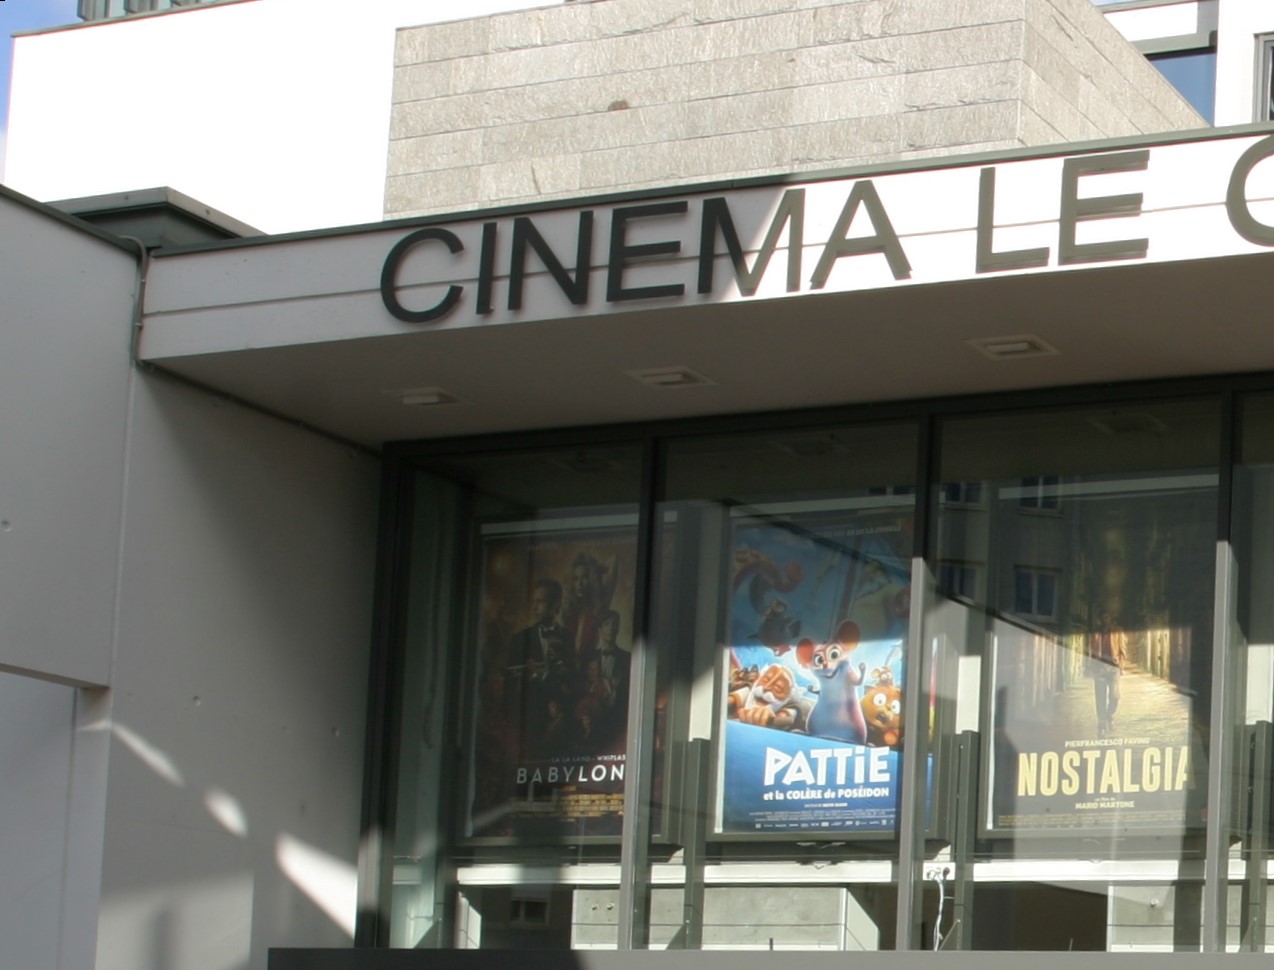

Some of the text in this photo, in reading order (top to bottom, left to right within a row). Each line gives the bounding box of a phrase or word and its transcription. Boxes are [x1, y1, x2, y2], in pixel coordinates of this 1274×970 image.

[379, 178, 914, 324] CINEMA
[974, 149, 1151, 275] LE
[1064, 737, 1123, 748] PIERFRANCESCO
[516, 764, 625, 784] BABYLON
[1017, 746, 1196, 797] NOSTALGIA
[763, 785, 889, 800] et la COLÈRE de POSÉIDON
